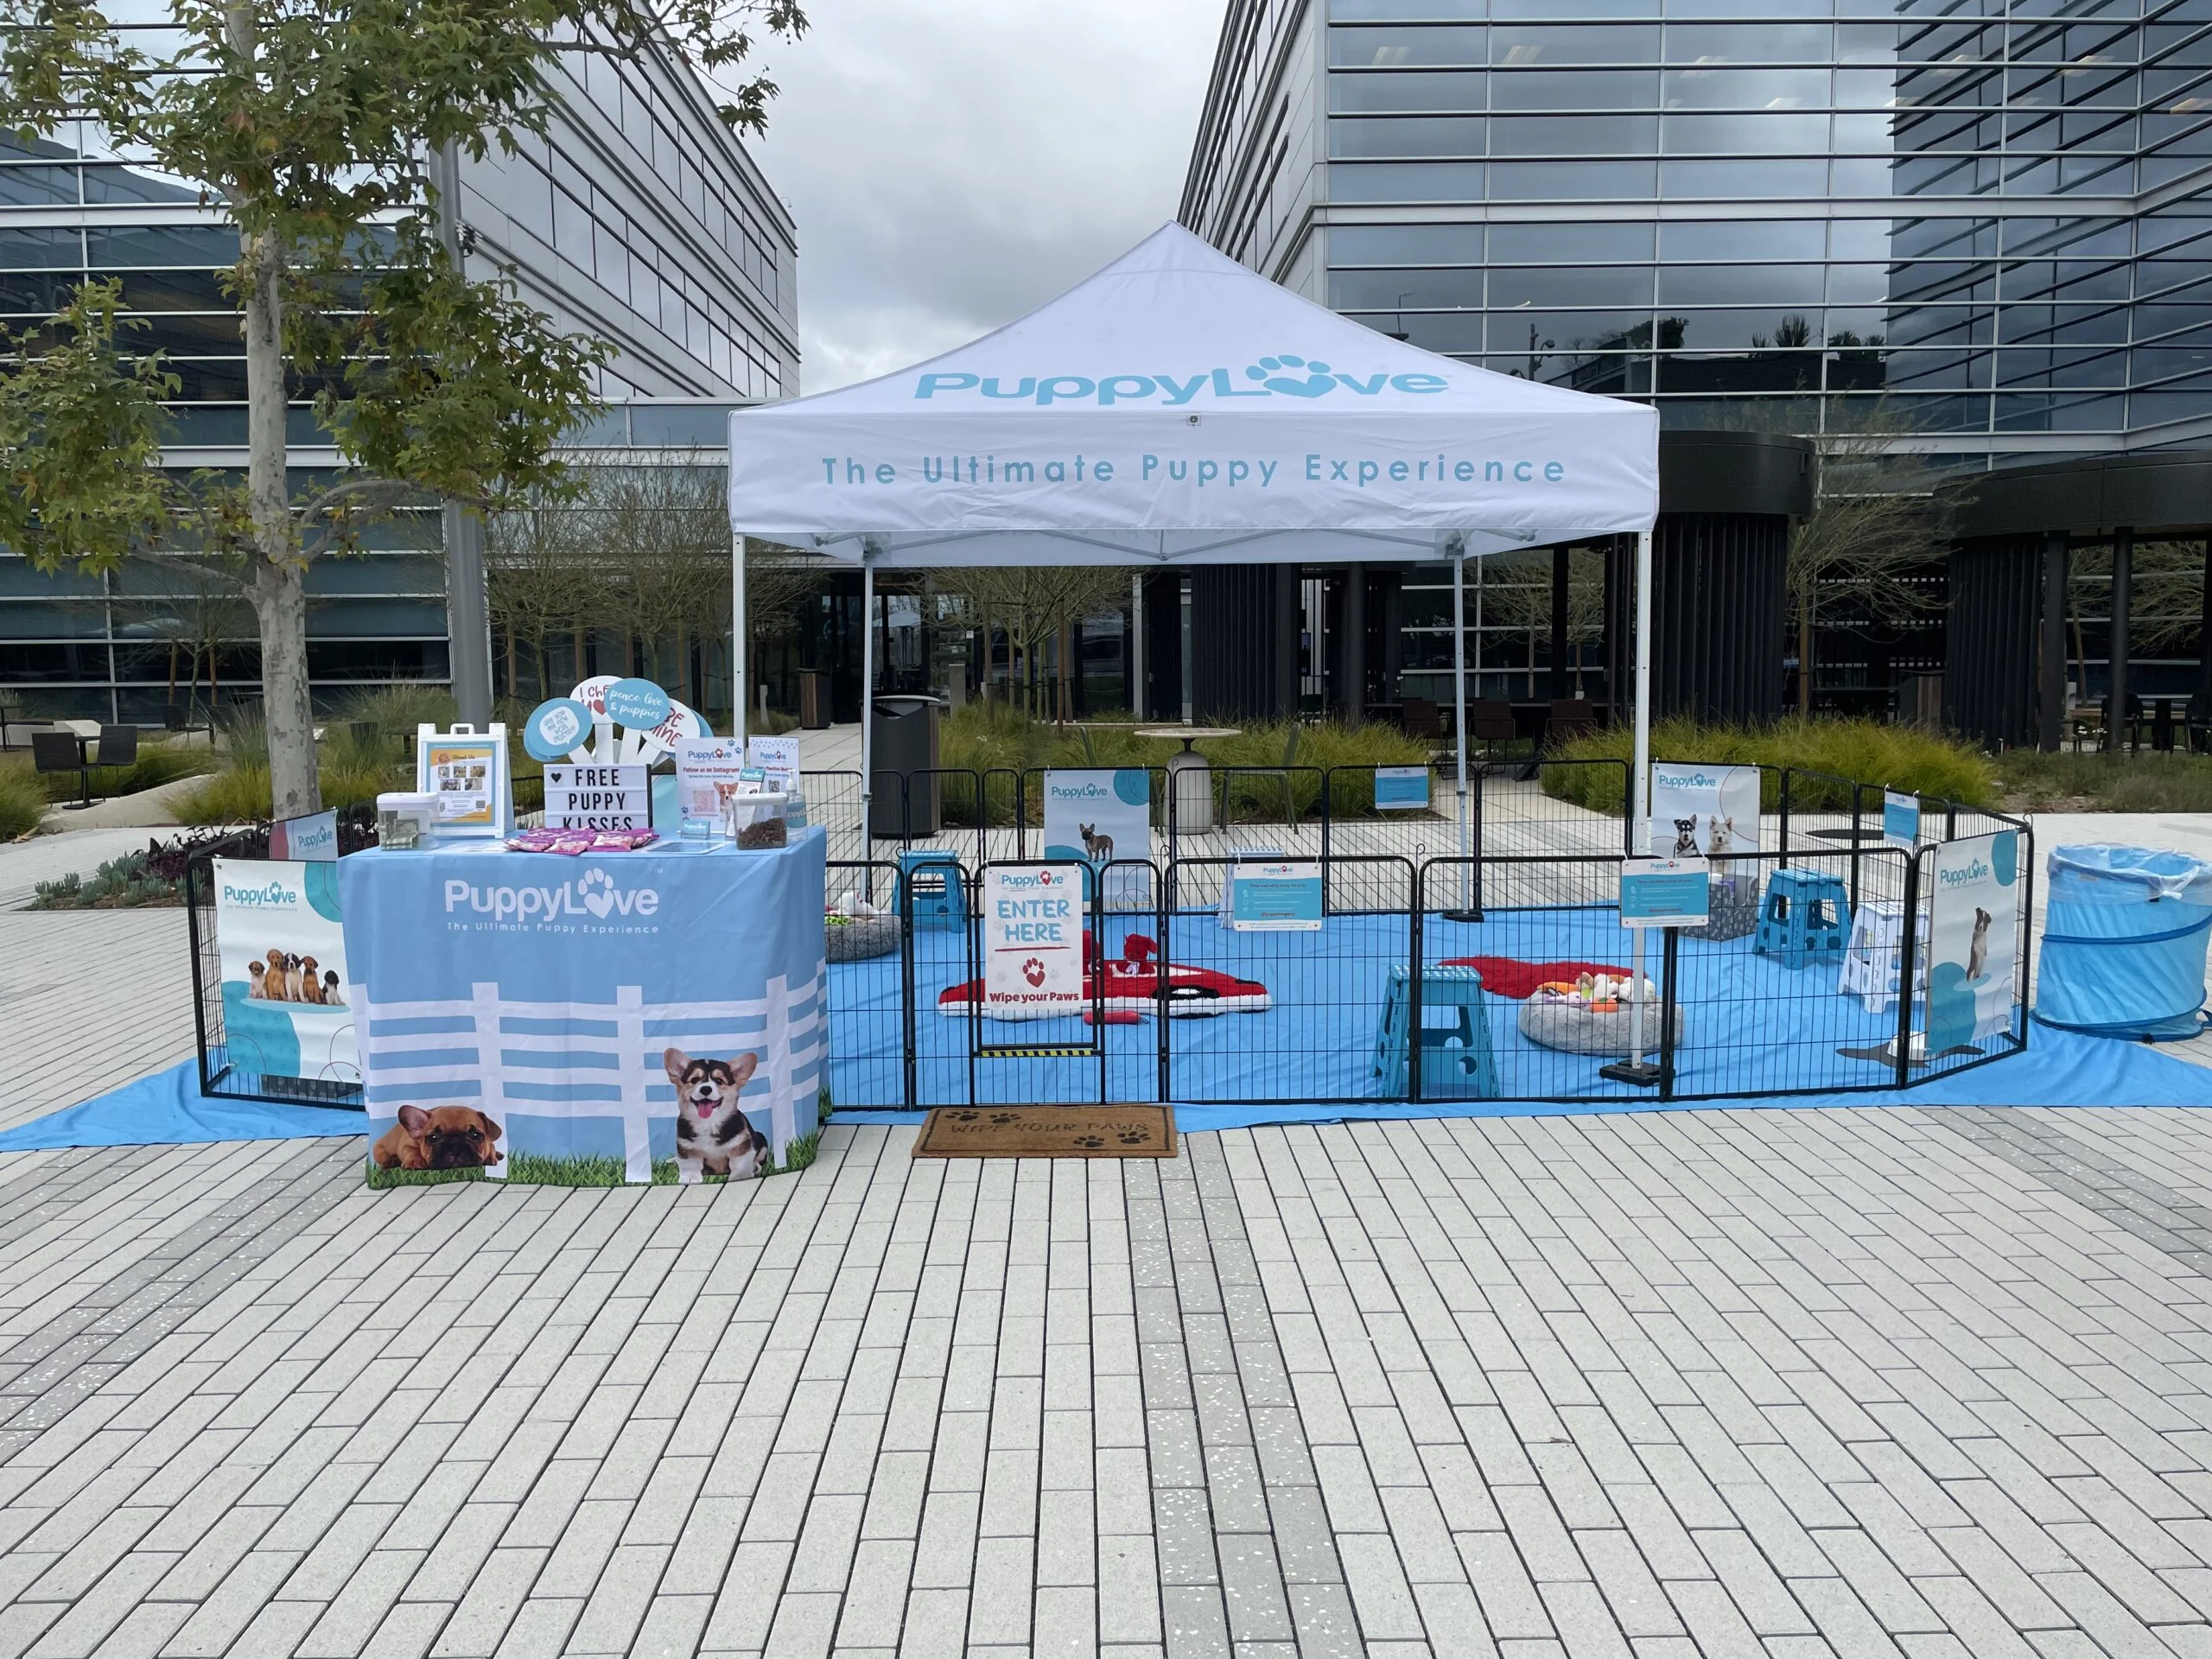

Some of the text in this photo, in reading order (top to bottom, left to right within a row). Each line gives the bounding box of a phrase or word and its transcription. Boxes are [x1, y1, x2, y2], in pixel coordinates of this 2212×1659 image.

[823, 453, 1565, 490] The Ultimate Puppy Experience
[619, 704, 660, 720] puppies
[575, 768, 620, 786] FREE
[569, 792, 626, 810] PUPPY
[563, 817, 632, 830] KISSES
[997, 899, 1071, 918] ENTER
[447, 922, 659, 934] The Ultimate Puppy Experience
[1004, 923, 1064, 942] HERE
[989, 992, 1079, 1004] Wipe your Paws
[950, 1122, 1149, 1133] WIPE YOUR PAWS
